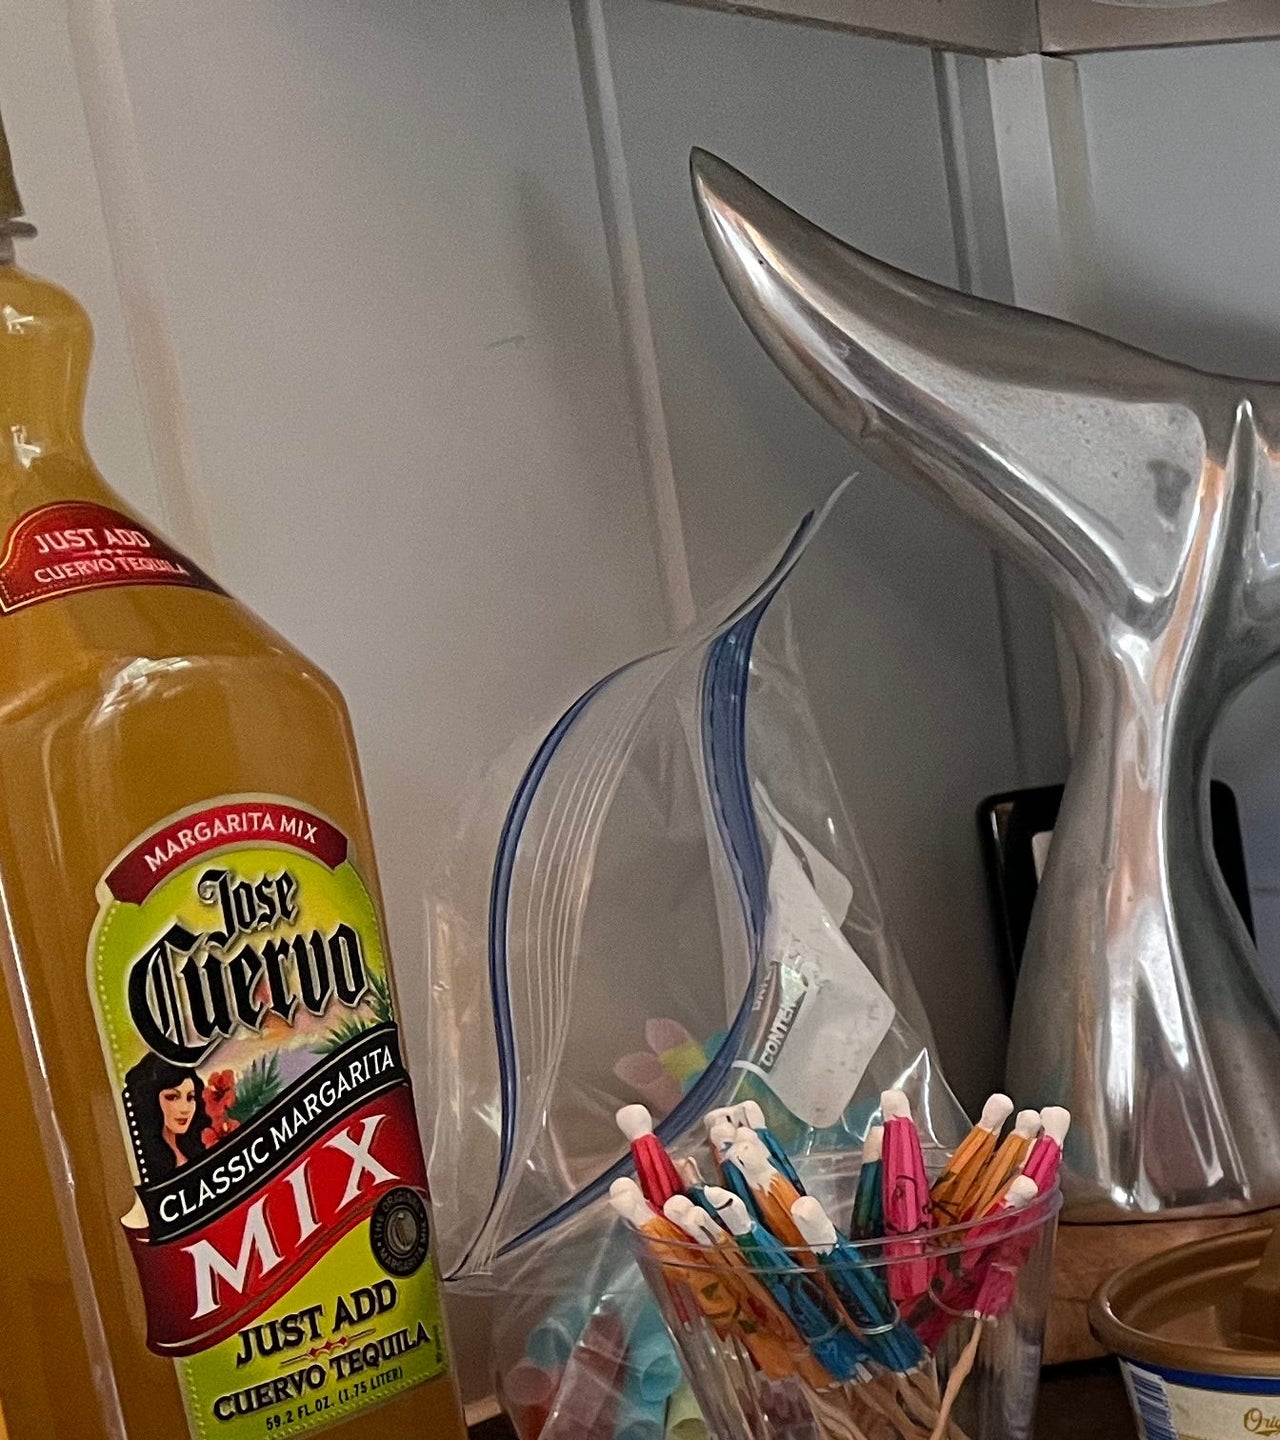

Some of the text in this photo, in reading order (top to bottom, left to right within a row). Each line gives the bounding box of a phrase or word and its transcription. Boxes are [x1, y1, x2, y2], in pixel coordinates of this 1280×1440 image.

[33, 528, 151, 554] JUST ADD
[34, 556, 191, 584] CUERVO TEQUILA
[144, 811, 318, 873] MARGARITA MIX
[197, 868, 299, 948] Jose
[128, 922, 370, 1067] Cuervo
[158, 1045, 396, 1224] CLASSIC MARGARITA
[180, 1113, 401, 1321] MIX
[235, 1278, 399, 1370] JUST ADD
[212, 1362, 328, 1424] CUERVO
[328, 1320, 432, 1381] TEQUILA
[266, 1410, 295, 1431] 59.2
[338, 1380, 368, 1405] (1.75
[369, 1365, 405, 1391] LITER)
